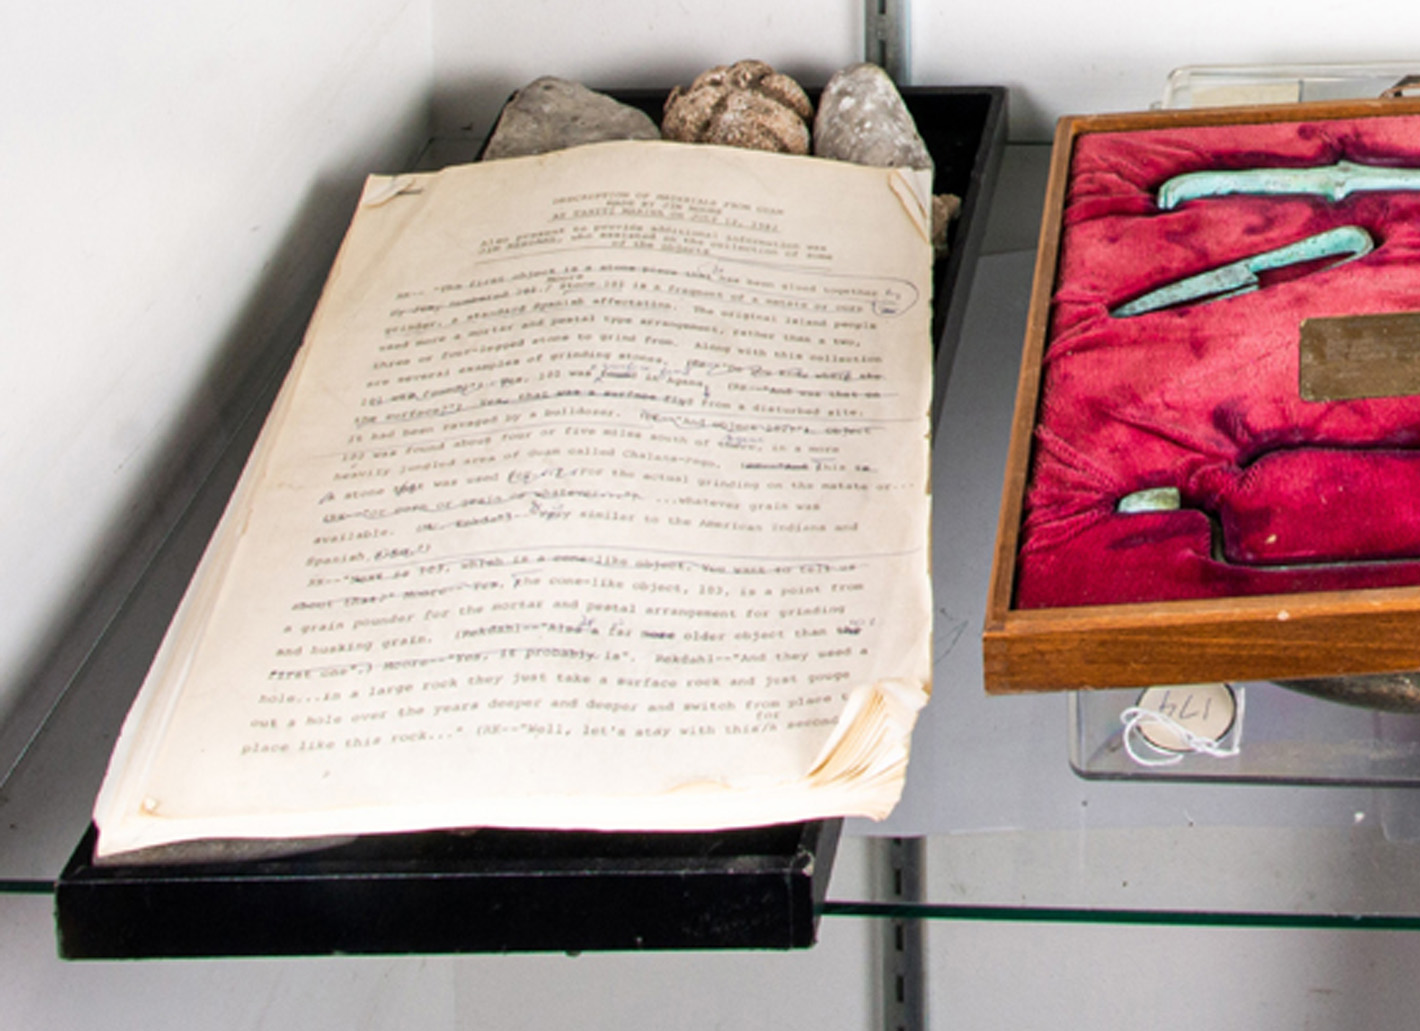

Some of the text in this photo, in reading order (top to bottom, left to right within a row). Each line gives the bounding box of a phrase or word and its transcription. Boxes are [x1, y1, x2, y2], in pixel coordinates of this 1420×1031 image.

[552, 192, 631, 206] DESCRIPTION
[635, 191, 651, 200] OF
[655, 193, 718, 207] MATERIALS
[723, 201, 752, 211] FROM
[641, 200, 655, 208] BY
[479, 223, 828, 252] Also present to provide additional information was
[570, 232, 593, 242] who
[599, 228, 658, 242] assisted
[683, 237, 705, 246] the
[709, 241, 779, 257] collection
[784, 247, 800, 258] of
[806, 252, 834, 261] some
[611, 239, 628, 249] of
[632, 240, 655, 250] the
[469, 275, 506, 289] first
[510, 267, 558, 283] object
[745, 278, 775, 289] been
[780, 282, 817, 293] glued
[823, 286, 879, 298] together
[466, 303, 527, 322] standard
[532, 297, 585, 313] Spanish
[693, 305, 715, 316] The
[720, 310, 777, 323] original
[785, 316, 828, 328] island
[833, 321, 878, 331] people
[378, 340, 410, 352] used
[414, 335, 447, 347] more
[467, 323, 514, 338] mortar
[520, 318, 545, 330] and
[603, 315, 633, 325] type
[732, 328, 776, 341] rather
[783, 333, 812, 344] than
[372, 358, 412, 370] three
[440, 337, 526, 362] four-legged
[531, 334, 571, 345] stone
[599, 333, 637, 343] grind
[693, 341, 732, 355] Along
[736, 347, 768, 357] with
[773, 350, 804, 361] this
[808, 354, 883, 364] collection
[366, 379, 390, 389] are
[397, 368, 451, 384] several
[457, 358, 521, 375] examples
[549, 350, 612, 362] grinding
[568, 368, 594, 378] was
[701, 397, 863, 417] from disturbed site.
[370, 413, 500, 441] had been ravaged
[372, 426, 689, 459] was found about four five miles south
[807, 445, 840, 454] more
[332, 446, 616, 481] heavily jungled area Guam called
[465, 472, 500, 485] used
[642, 472, 815, 492] actual grinding the
[343, 487, 386, 499] stone
[748, 501, 789, 513] grain
[579, 510, 859, 532] similar American and
[312, 528, 394, 545] available.
[631, 581, 689, 596] object,
[780, 585, 821, 598] point
[830, 583, 865, 593] from
[300, 621, 345, 635] grain
[351, 613, 416, 631] pounder
[423, 608, 451, 621] for
[458, 604, 485, 616] the
[490, 600, 544, 612] mortar
[552, 599, 580, 610] and
[644, 606, 737, 619] arrangement
[745, 608, 769, 619] for
[778, 605, 846, 619] grinding
[309, 635, 433, 655] husking grain.
[682, 627, 828, 643] older object than
[774, 646, 853, 662] they used
[368, 683, 414, 697] large
[421, 677, 458, 691] rock
[467, 674, 504, 686] they
[512, 672, 547, 685] just
[556, 673, 591, 684] take
[616, 676, 678, 689] surface
[685, 677, 721, 688] rock
[764, 674, 798, 688] just
[807, 671, 851, 685] gouge
[249, 694, 833, 729] out hole over years deeper deeper switch from place
[240, 742, 290, 756] place
[298, 740, 336, 752] like
[344, 736, 382, 749] this
[582, 724, 626, 737] let's
[634, 727, 671, 738] stay
[679, 725, 716, 736] with
